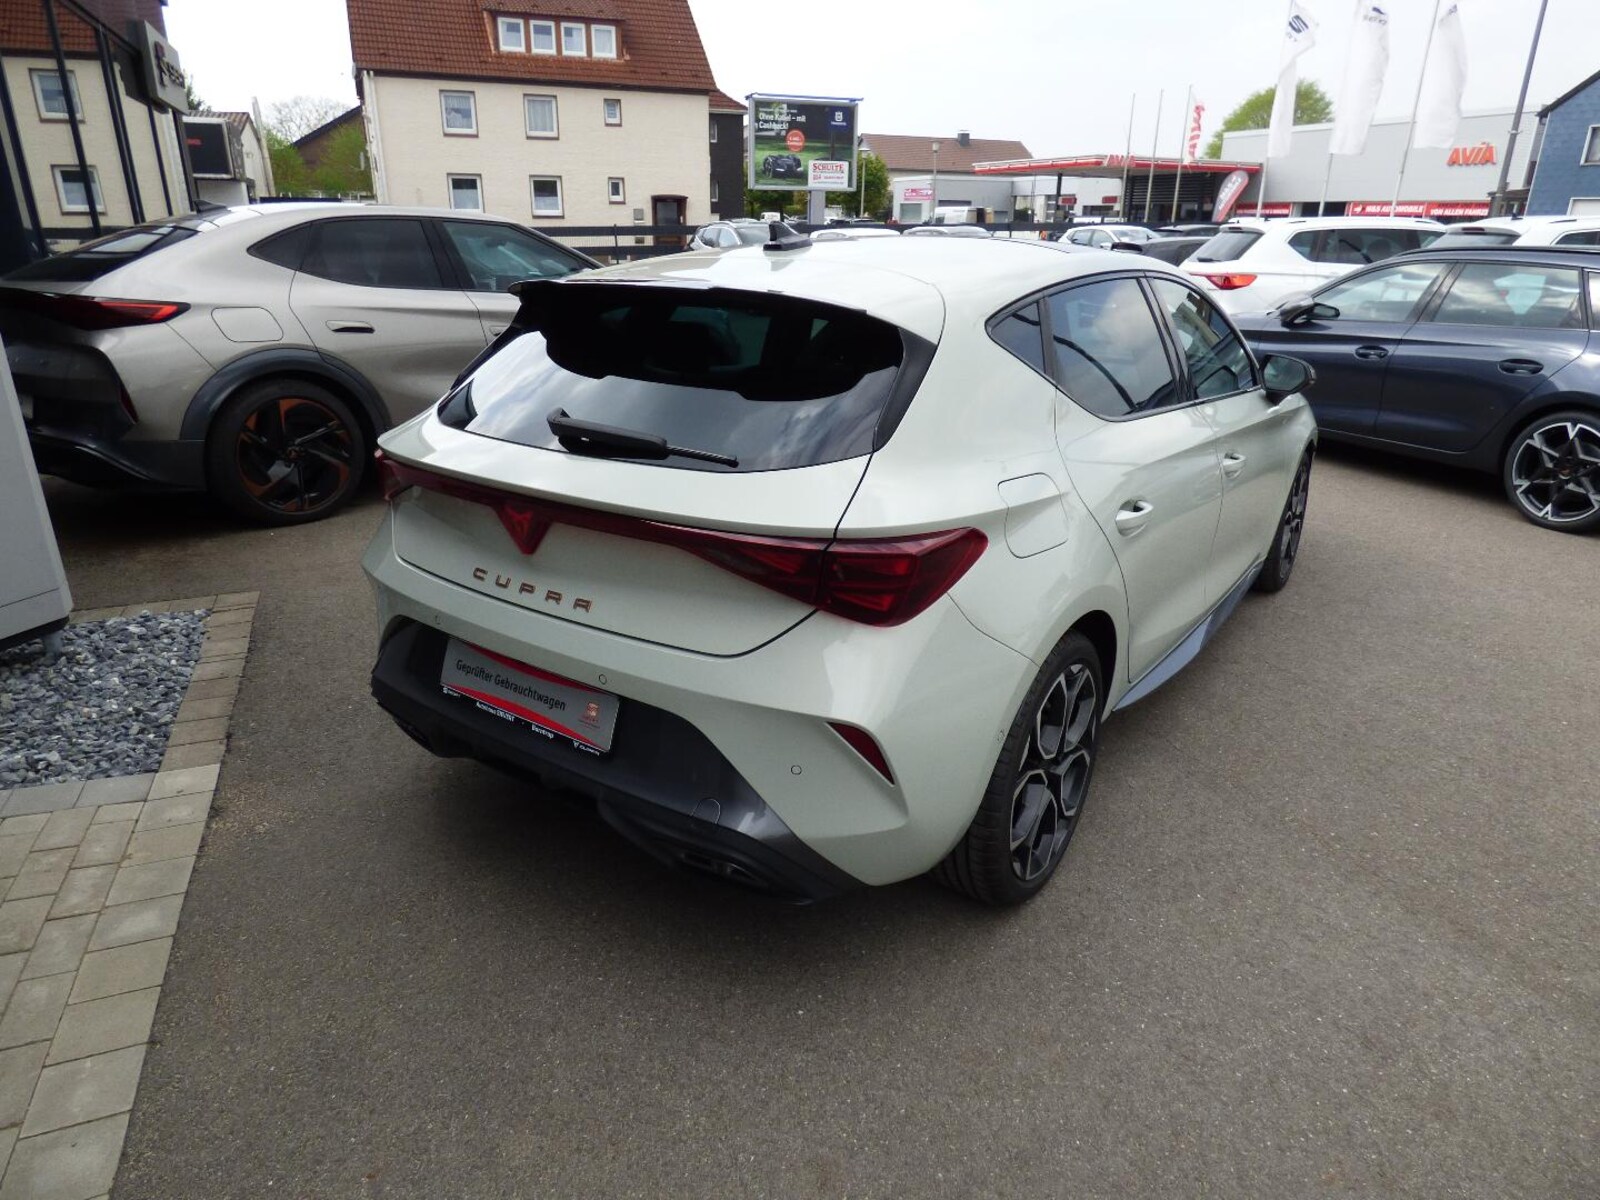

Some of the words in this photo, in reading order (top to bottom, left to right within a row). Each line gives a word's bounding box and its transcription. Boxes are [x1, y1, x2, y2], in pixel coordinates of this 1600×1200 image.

[1447, 142, 1497, 167] AVIA
[1381, 204, 1423, 213] AUOMOBILE
[473, 567, 592, 613] CUPRA
[456, 659, 493, 682] Geprüfter
[494, 674, 567, 711] Gebrauchtwagen
